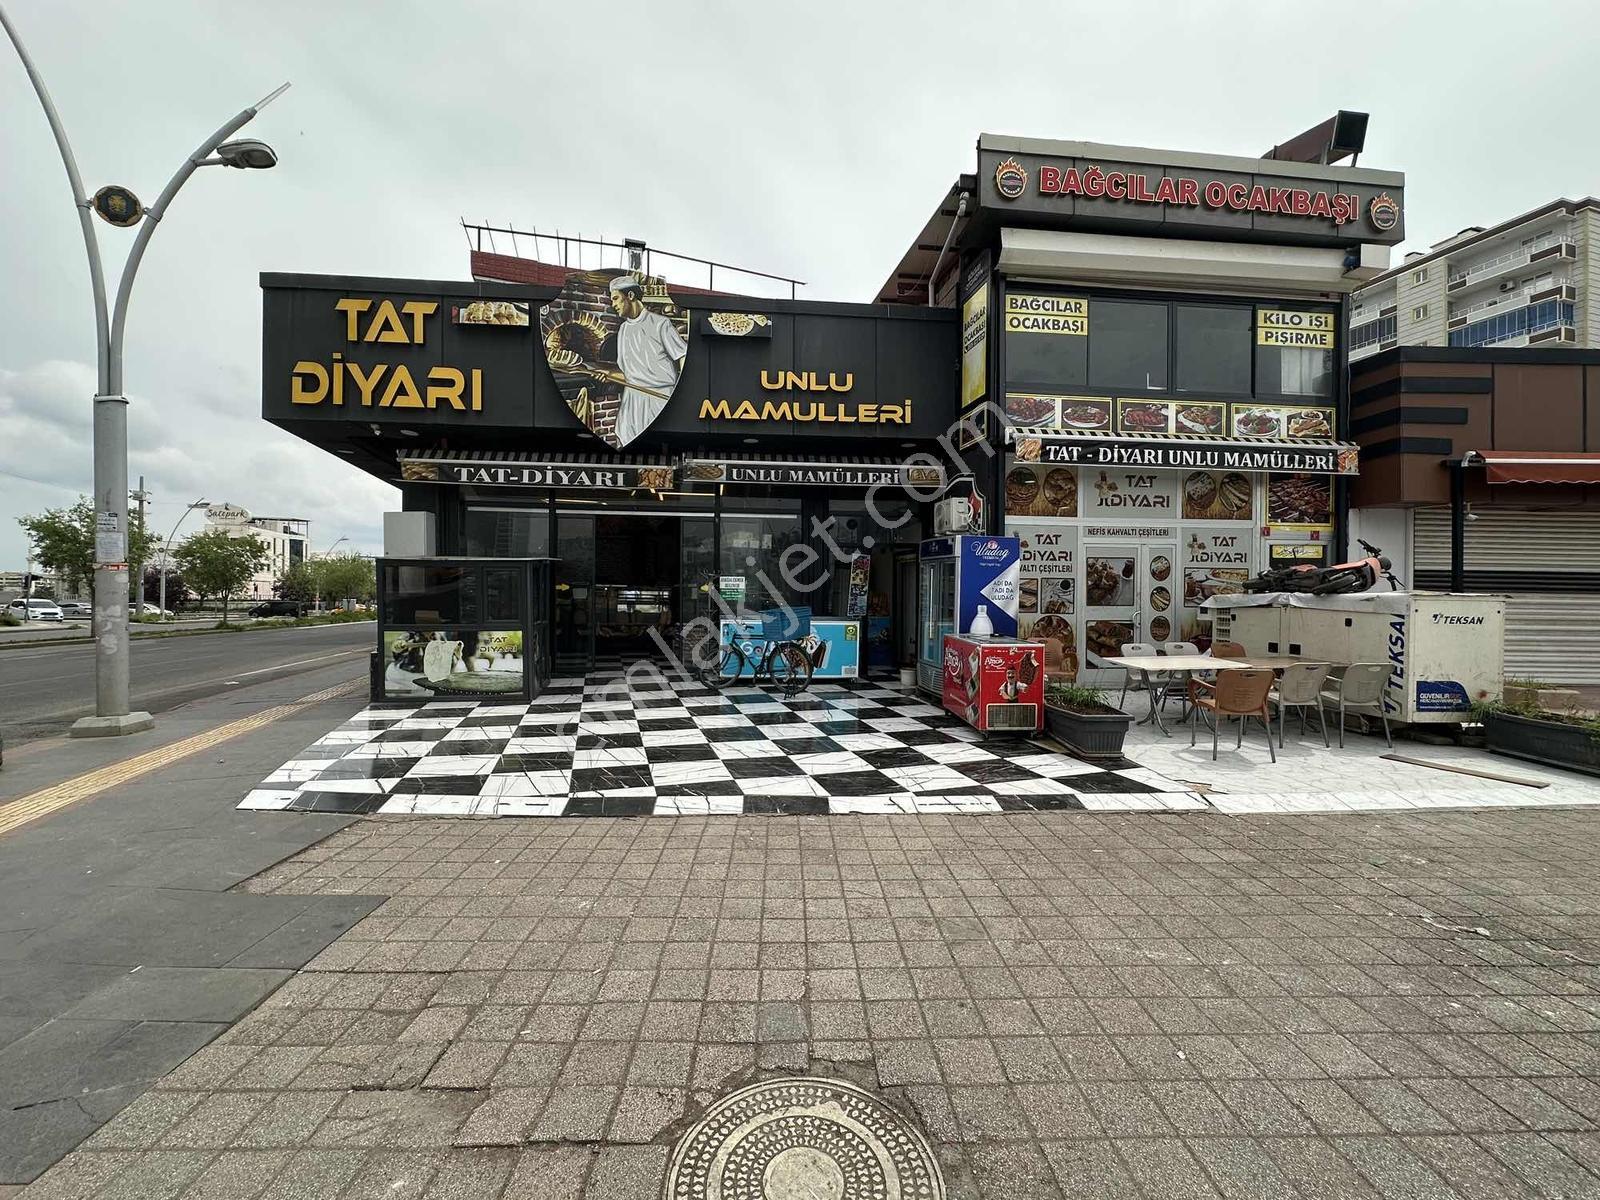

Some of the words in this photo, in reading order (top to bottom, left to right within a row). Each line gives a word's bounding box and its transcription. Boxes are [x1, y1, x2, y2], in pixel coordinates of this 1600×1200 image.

[1039, 165, 1200, 206] BAĞCILAR
[1204, 180, 1360, 225] OCAKBAŞI
[1009, 297, 1083, 314] BAĞCILAR
[335, 298, 438, 345] TAT
[1009, 316, 1085, 334] OCAKBAŞI
[1263, 311, 1302, 327] KİLO
[1308, 313, 1329, 329] İŞİ
[1264, 330, 1328, 346] PİŞİRME
[291, 352, 483, 411] DİYARI
[760, 370, 853, 392] UNLU
[699, 399, 912, 424] MAMULLERİ
[1046, 445, 1082, 462] TAT
[1098, 444, 1163, 464] DİYARI
[1168, 449, 1219, 466] UNLU
[1223, 449, 1335, 470] MAMÜLLERİ
[732, 467, 783, 482] UNLU
[788, 467, 900, 485] MAMÜLLERİ
[1124, 474, 1158, 488] TAT
[1111, 493, 1170, 508] DİYARI
[1035, 533, 1062, 545] TAT
[1087, 526, 1106, 535] NEFİS
[1107, 527, 1136, 536] KAHVALTI
[1138, 527, 1169, 537] ÇEŞİTLERİ
[1211, 536, 1238, 547] TAT
[1022, 550, 1073, 562] DİYARI
[1200, 552, 1248, 563] DİYARI
[1020, 564, 1037, 573] VALTI
[1038, 563, 1073, 574] ÇEŞİTLERİ
[1443, 615, 1485, 625] TEKSAN
